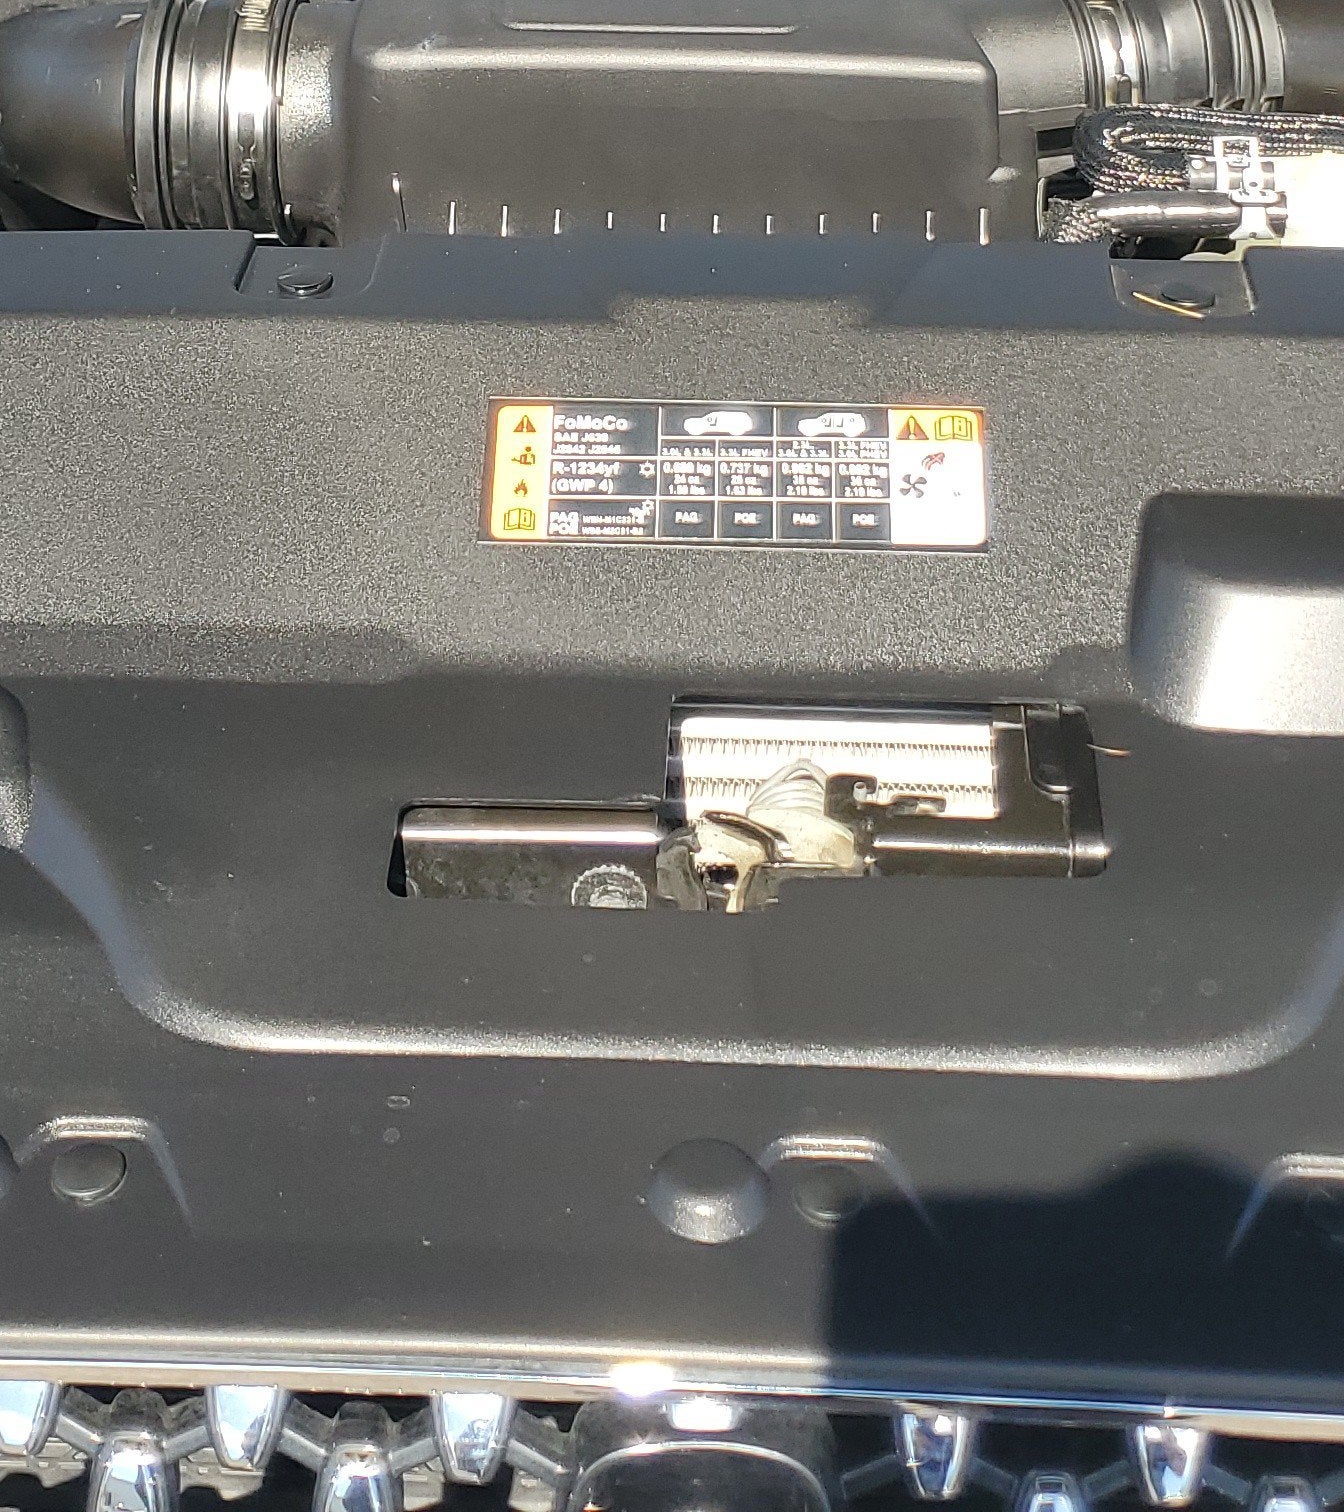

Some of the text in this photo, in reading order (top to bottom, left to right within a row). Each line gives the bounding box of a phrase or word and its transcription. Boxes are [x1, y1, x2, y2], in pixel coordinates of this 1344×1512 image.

[553, 414, 629, 431] FoMoCo
[552, 461, 621, 478] R-1234yf
[696, 461, 712, 477] kg
[719, 461, 769, 478] 0.737 kg
[814, 462, 831, 478] kg
[872, 463, 888, 479] kg
[551, 477, 614, 495] (GWP 4)
[674, 511, 699, 524] PAG
[792, 512, 817, 526] PAG
